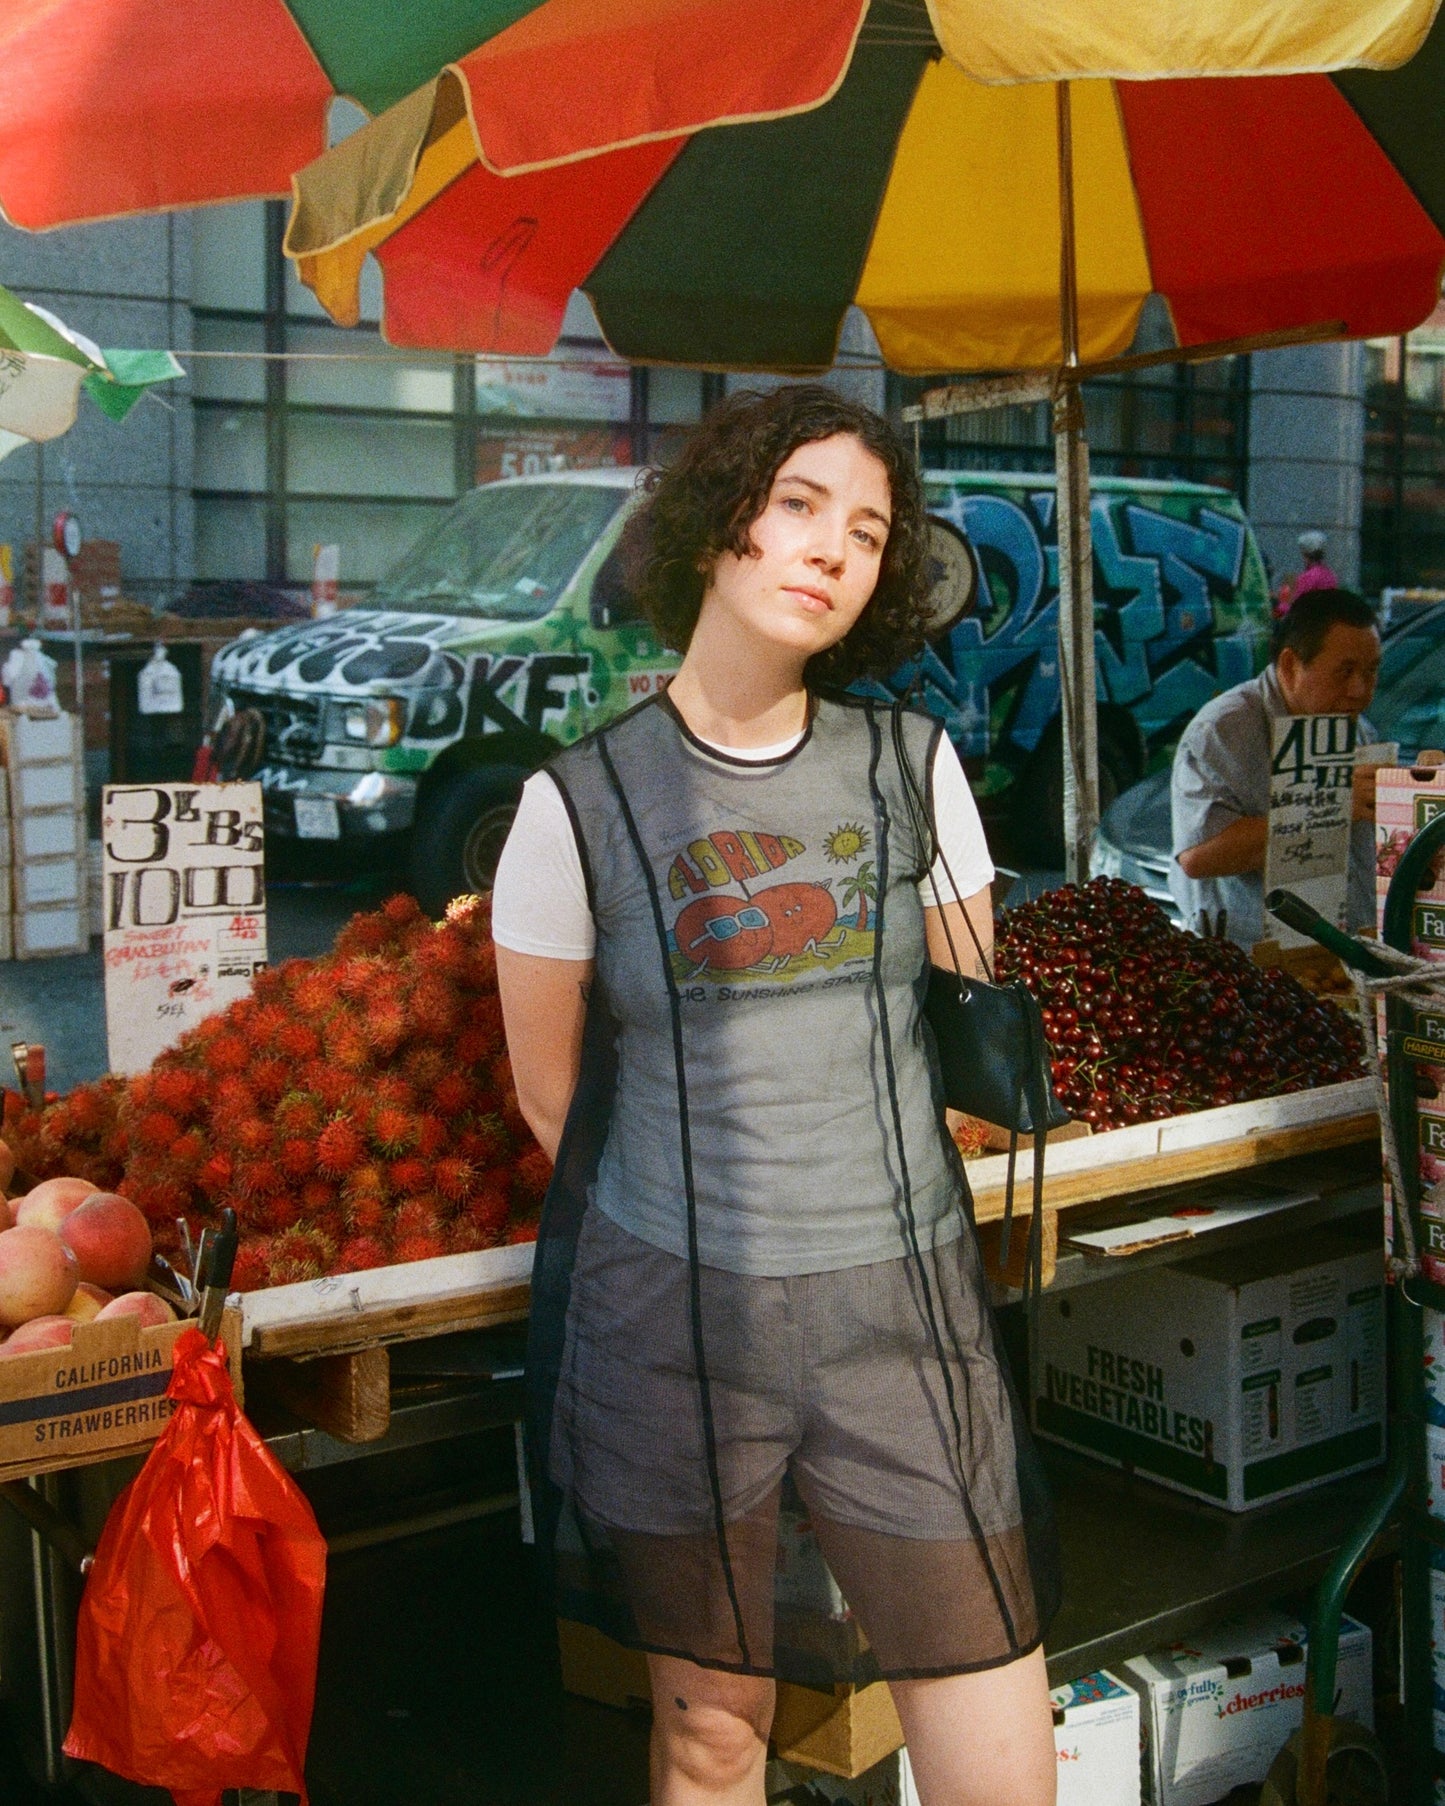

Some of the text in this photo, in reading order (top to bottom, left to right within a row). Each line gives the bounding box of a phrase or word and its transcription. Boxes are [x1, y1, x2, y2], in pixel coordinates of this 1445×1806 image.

[107, 788, 171, 863] 3
[668, 830, 805, 900] FLORIDA
[56, 1349, 162, 1388] CALIFORNIA
[1087, 1345, 1164, 1401] FRESH
[1054, 1367, 1204, 1453] VEGETABLES
[1226, 1683, 1305, 1717] cherries
